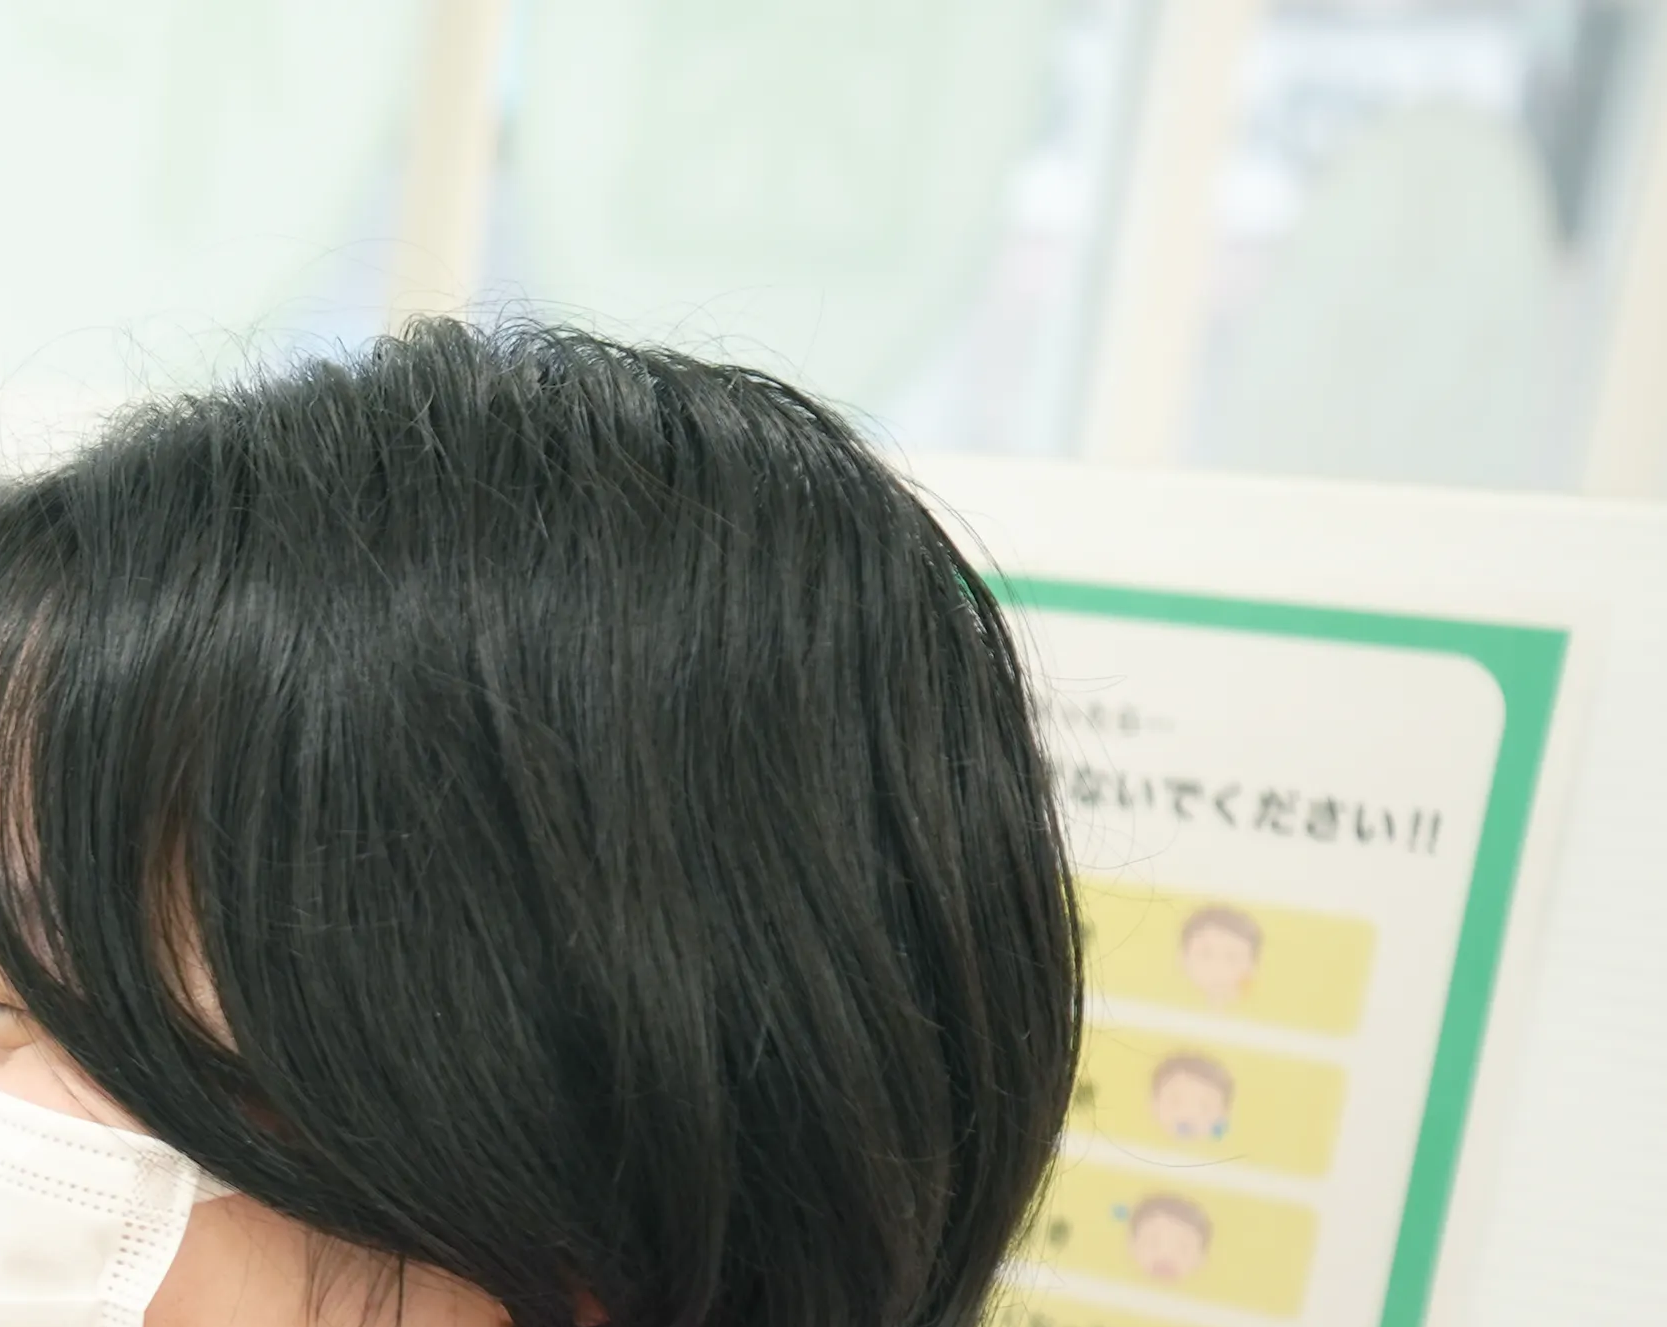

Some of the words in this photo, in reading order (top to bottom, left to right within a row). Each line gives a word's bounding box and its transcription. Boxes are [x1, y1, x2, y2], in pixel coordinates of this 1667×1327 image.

[1055, 763, 1443, 856] ないでください!!
